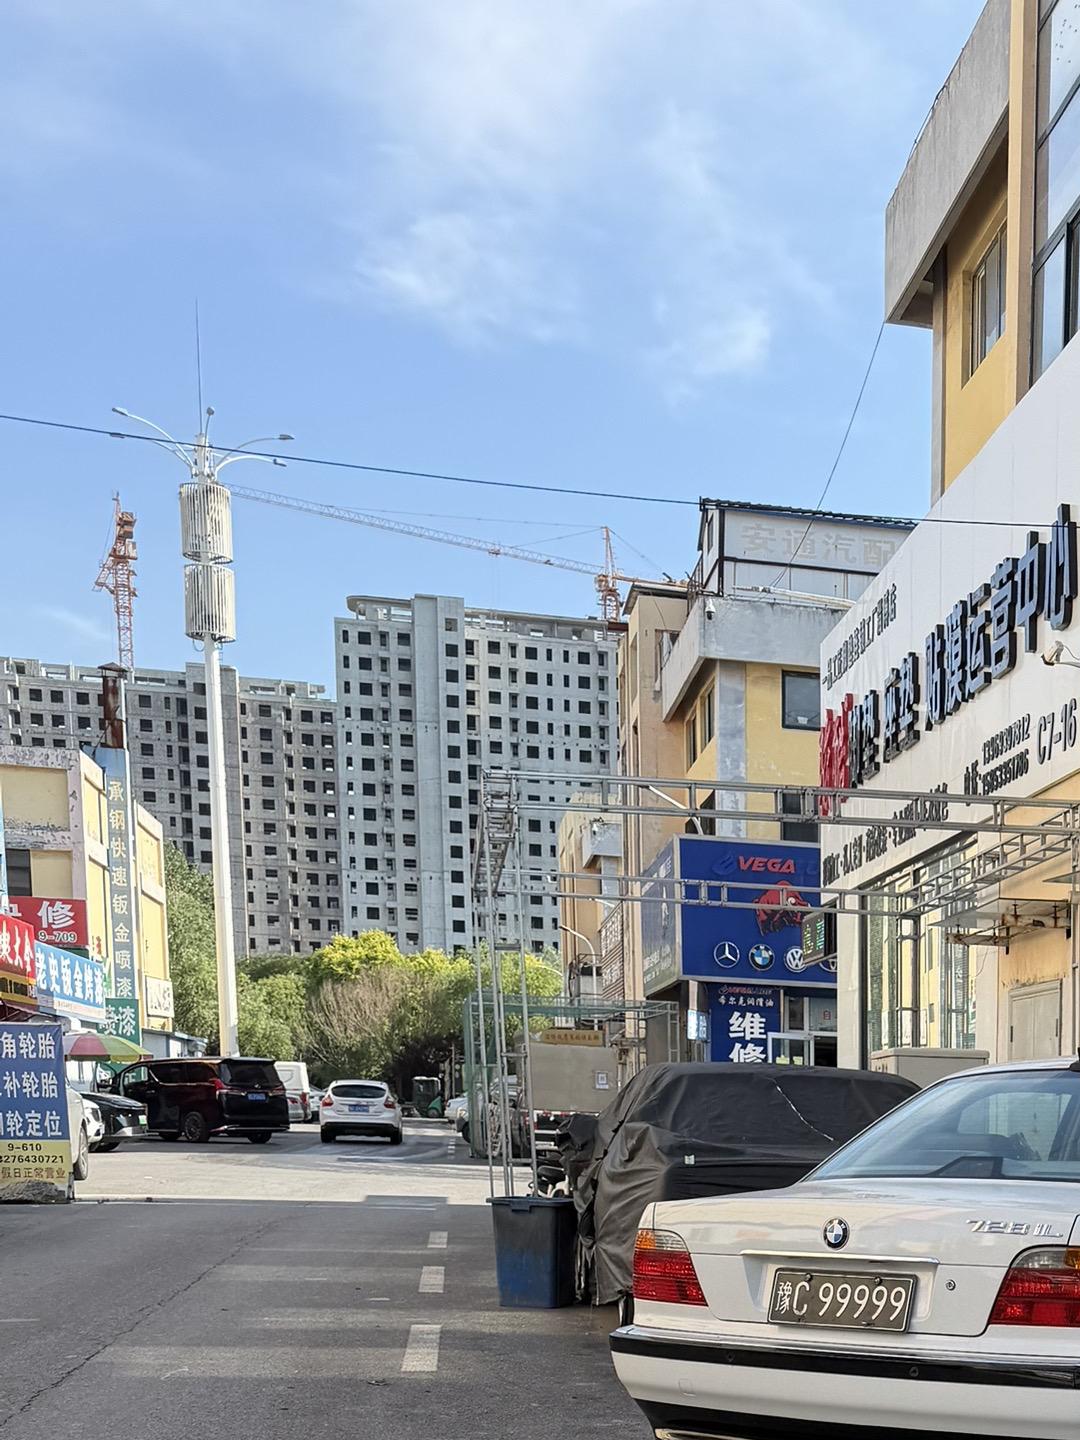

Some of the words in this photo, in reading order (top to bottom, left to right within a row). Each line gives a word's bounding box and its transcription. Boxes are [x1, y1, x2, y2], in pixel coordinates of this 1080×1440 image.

[924, 503, 1078, 732] 贴膜运营中心
[1037, 698, 1077, 765] C7-16
[738, 856, 796, 874] VEGA
[728, 1011, 767, 1063] 维修
[7, 1143, 42, 1151] 9-610
[818, 1282, 906, 1321] 99999
